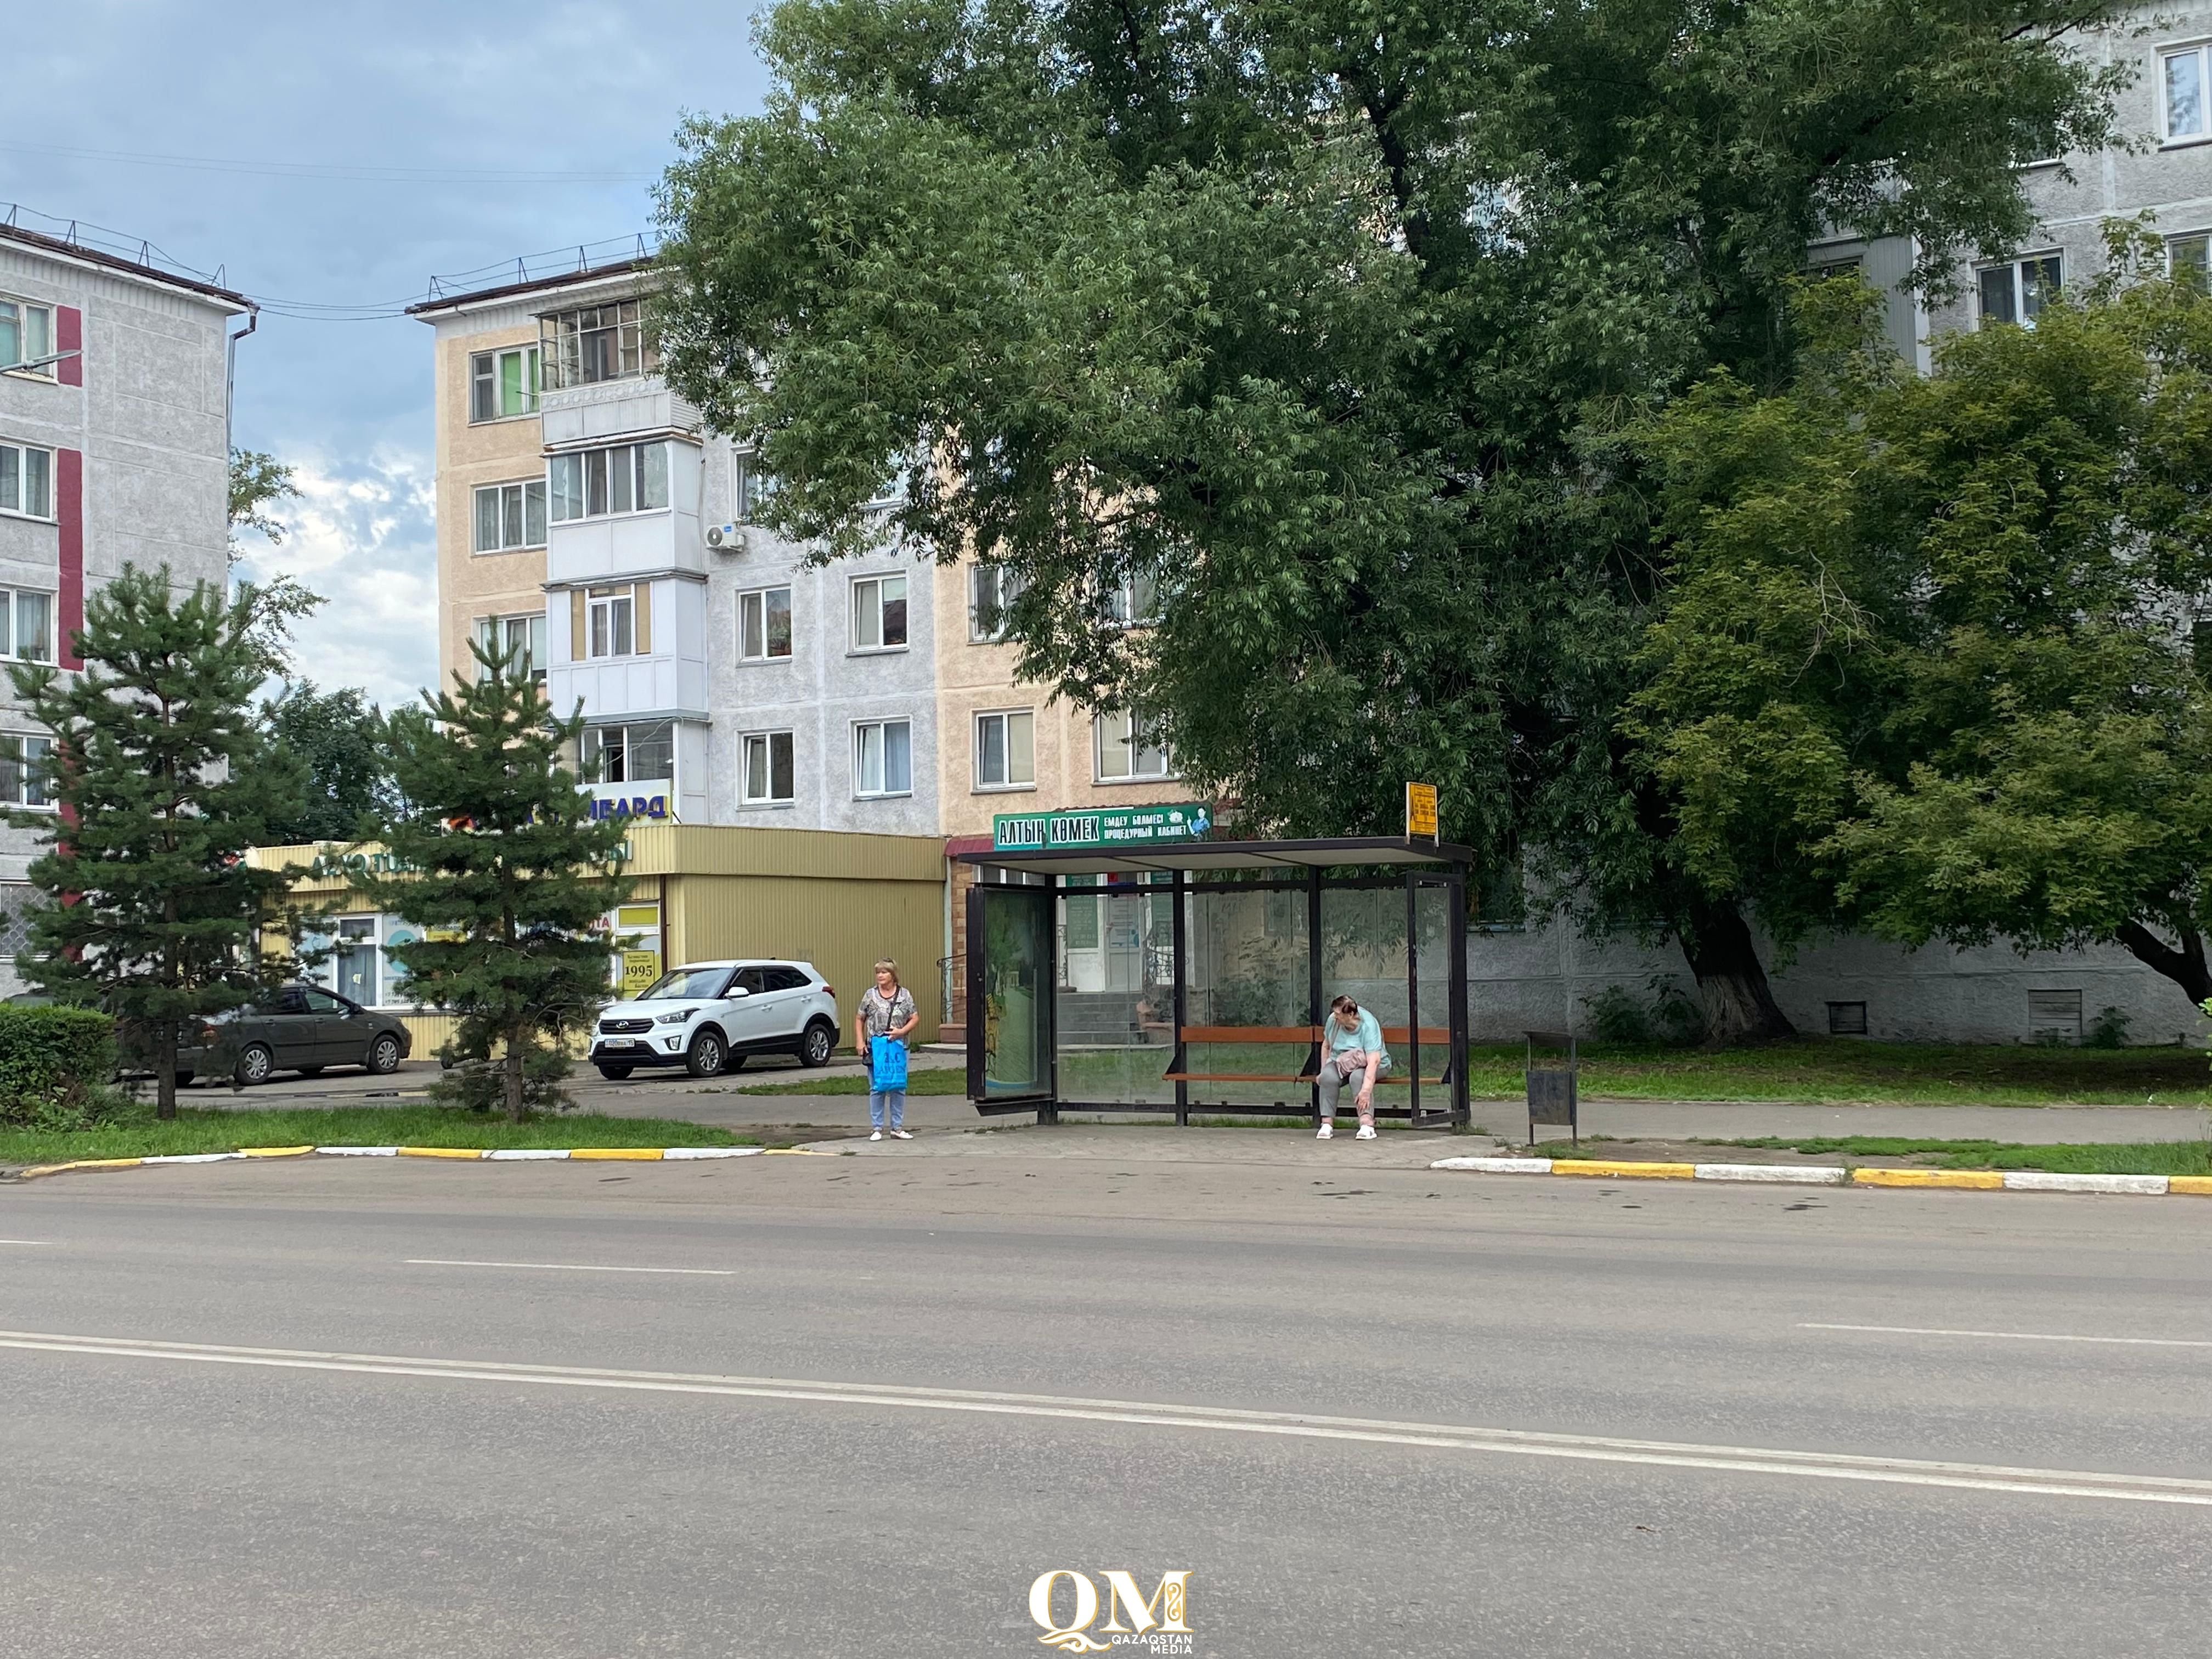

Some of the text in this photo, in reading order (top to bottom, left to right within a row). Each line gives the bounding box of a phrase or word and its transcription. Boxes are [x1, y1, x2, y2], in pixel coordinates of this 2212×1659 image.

[1104, 816, 1128, 827] ЕМДЕУ
[998, 816, 1099, 845] АЛТЫН КӨМЕК
[1158, 825, 1187, 837] КАБИНЕТ
[625, 965, 652, 977] 1995
